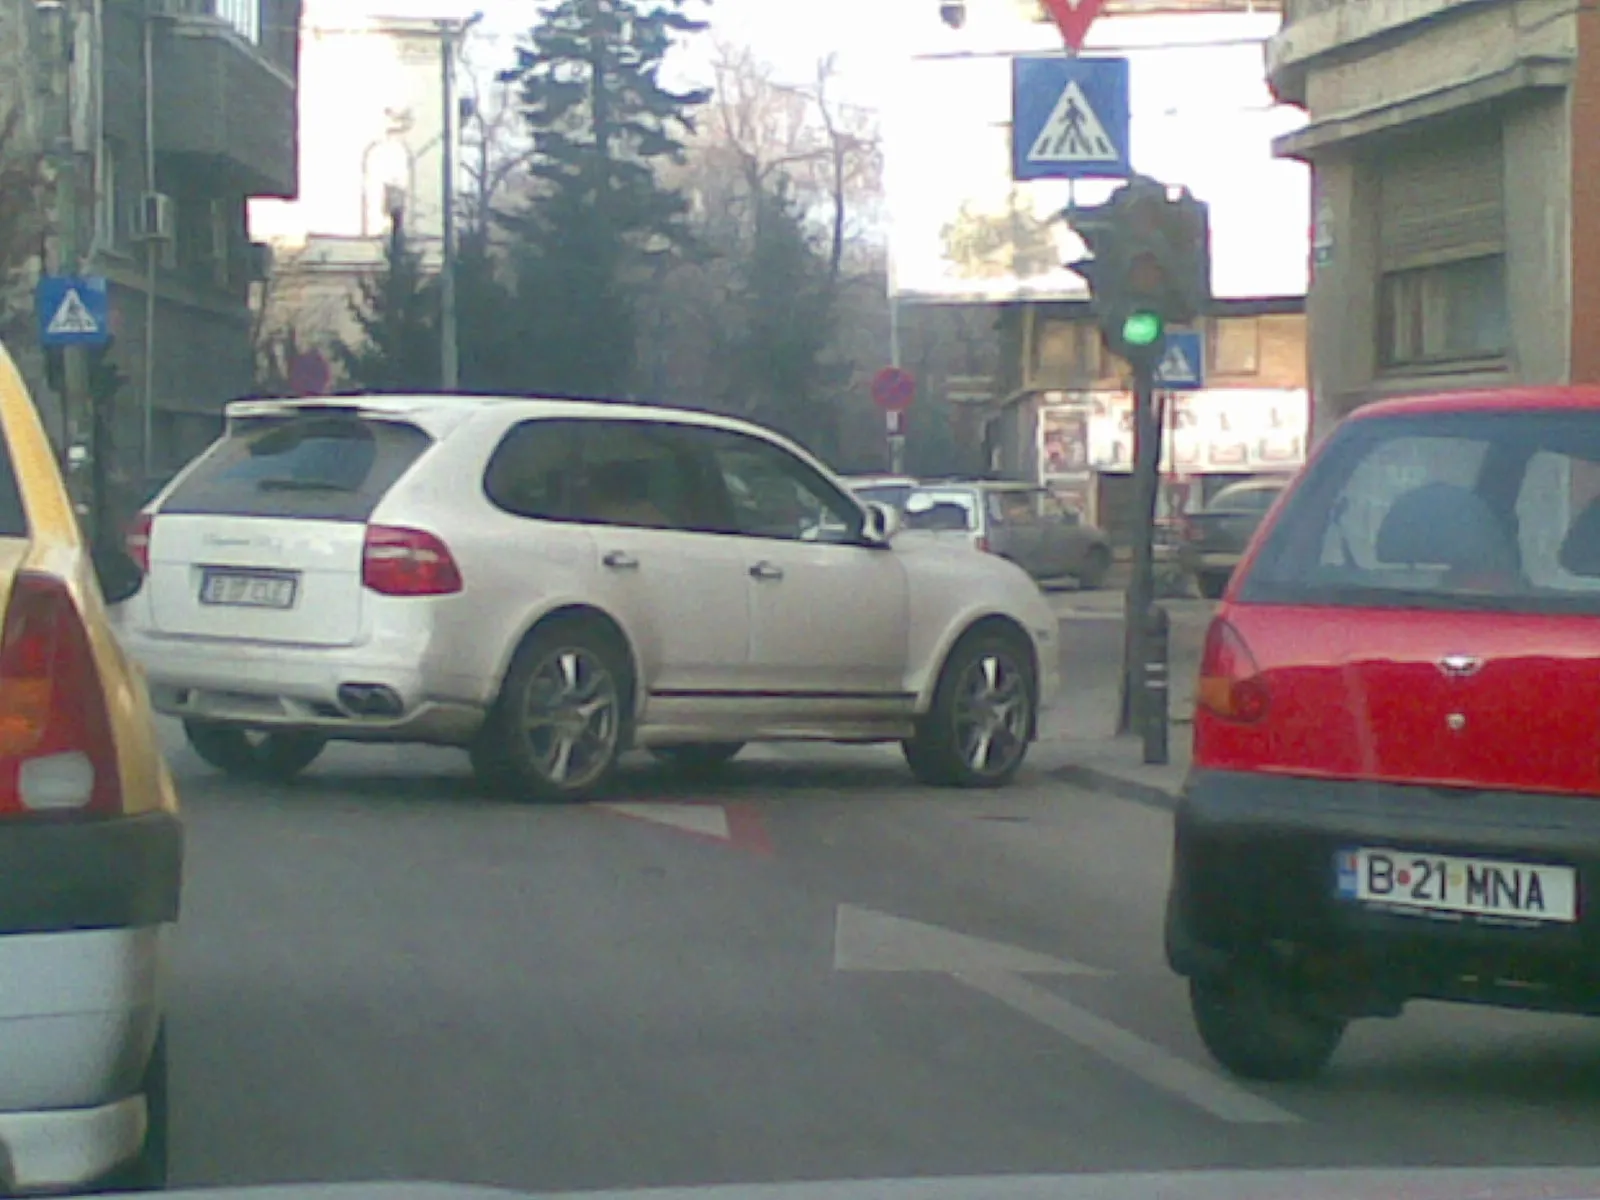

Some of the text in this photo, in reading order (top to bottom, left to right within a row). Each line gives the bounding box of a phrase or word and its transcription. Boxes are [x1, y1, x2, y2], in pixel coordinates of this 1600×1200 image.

[1367, 854, 1546, 911] B 21 MNA
